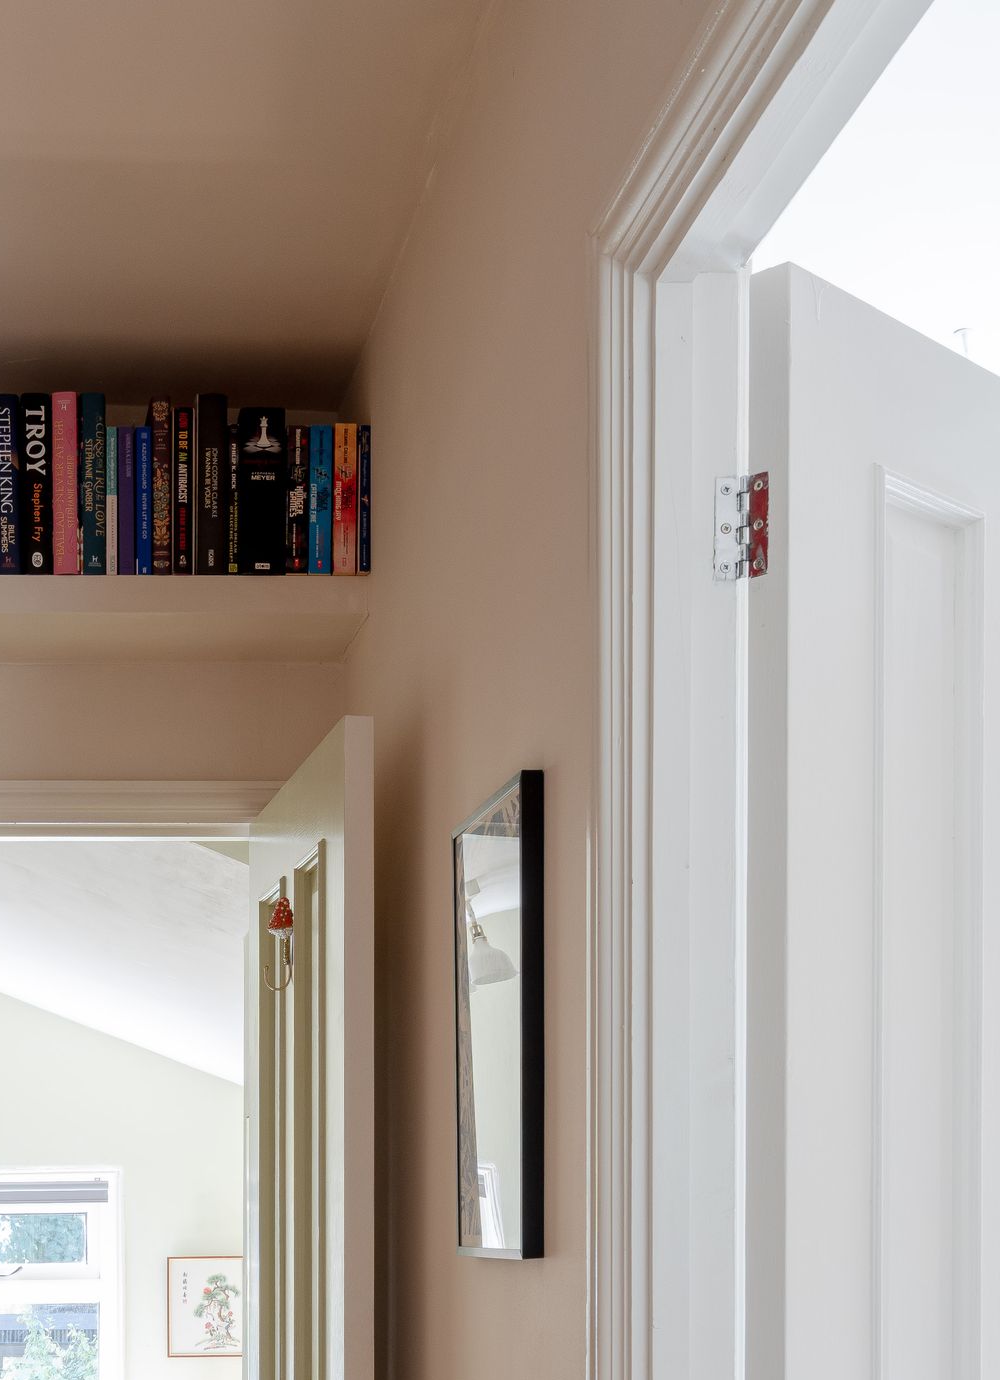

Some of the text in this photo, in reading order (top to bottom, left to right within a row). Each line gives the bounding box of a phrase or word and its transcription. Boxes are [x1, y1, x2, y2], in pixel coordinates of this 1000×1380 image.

[25, 405, 46, 476] TROY
[178, 431, 188, 439] TO
[179, 441, 188, 449] BE
[83, 438, 93, 512] STEPHANIE GARBER
[179, 452, 188, 462] AN
[0, 476, 13, 513] KING
[55, 463, 64, 502] NEVER
[95, 423, 105, 537] CURSE TRUE LOVE
[178, 463, 188, 503] ANTIRACIST
[32, 483, 43, 543] Stephen Fry
[66, 488, 75, 528] STEPHANIE
[289, 491, 297, 518] GAMES
[0, 516, 8, 553] SUMMERS
[8, 524, 16, 544] BILLY
[56, 511, 65, 555] BALLAD
[142, 529, 147, 539] GO
